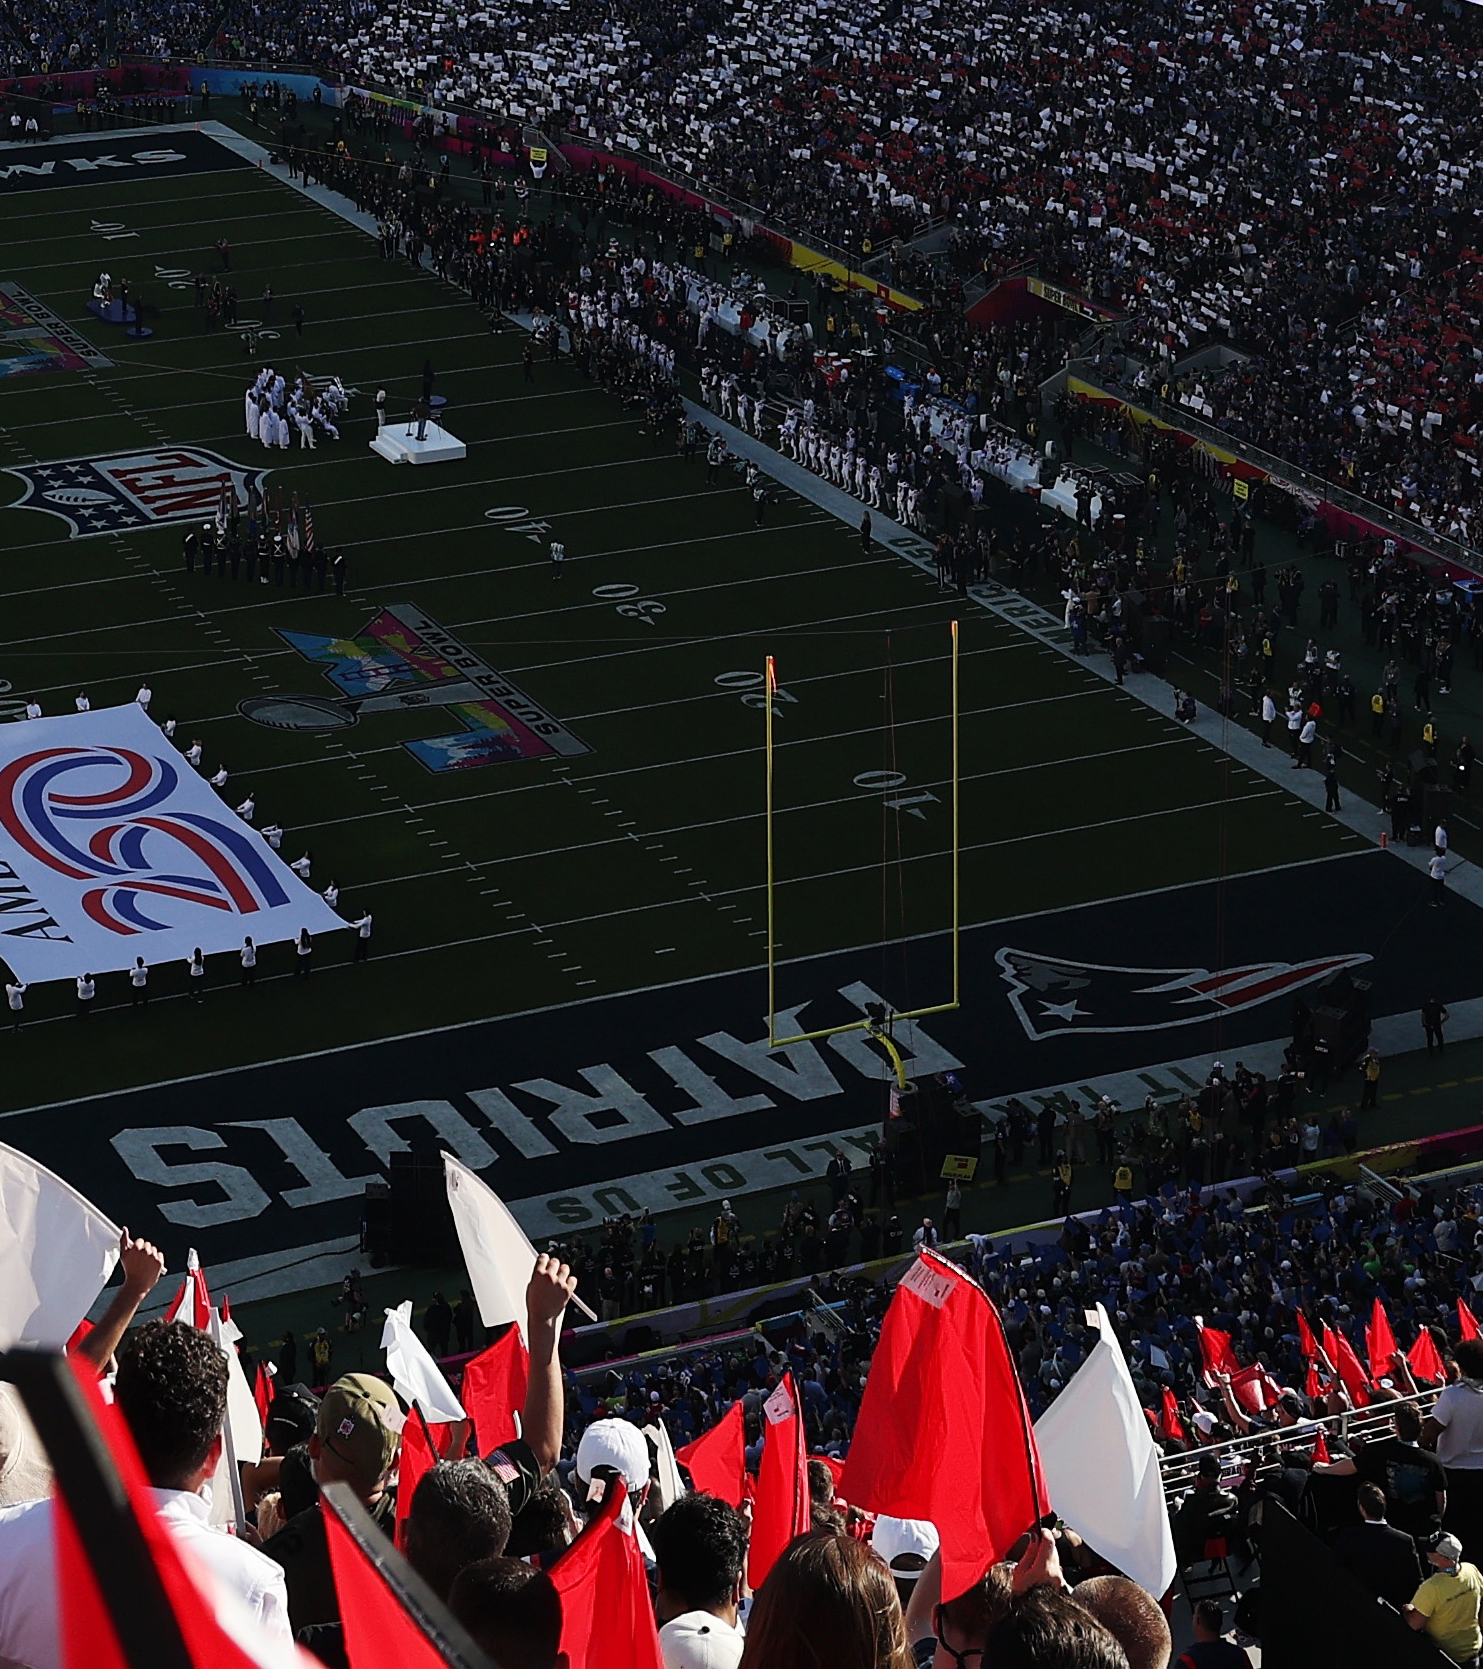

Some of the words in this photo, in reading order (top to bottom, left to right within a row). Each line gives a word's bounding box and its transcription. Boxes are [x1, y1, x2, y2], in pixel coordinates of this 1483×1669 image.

[11, 292, 51, 320] BOWL
[49, 319, 98, 358] SUPER
[112, 453, 228, 517] NFL
[415, 618, 482, 678] BOWL
[478, 675, 563, 737] SUPER
[110, 981, 966, 1229] PATRIOTS
[546, 1186, 637, 1227] US
[673, 1163, 749, 1200] OF
